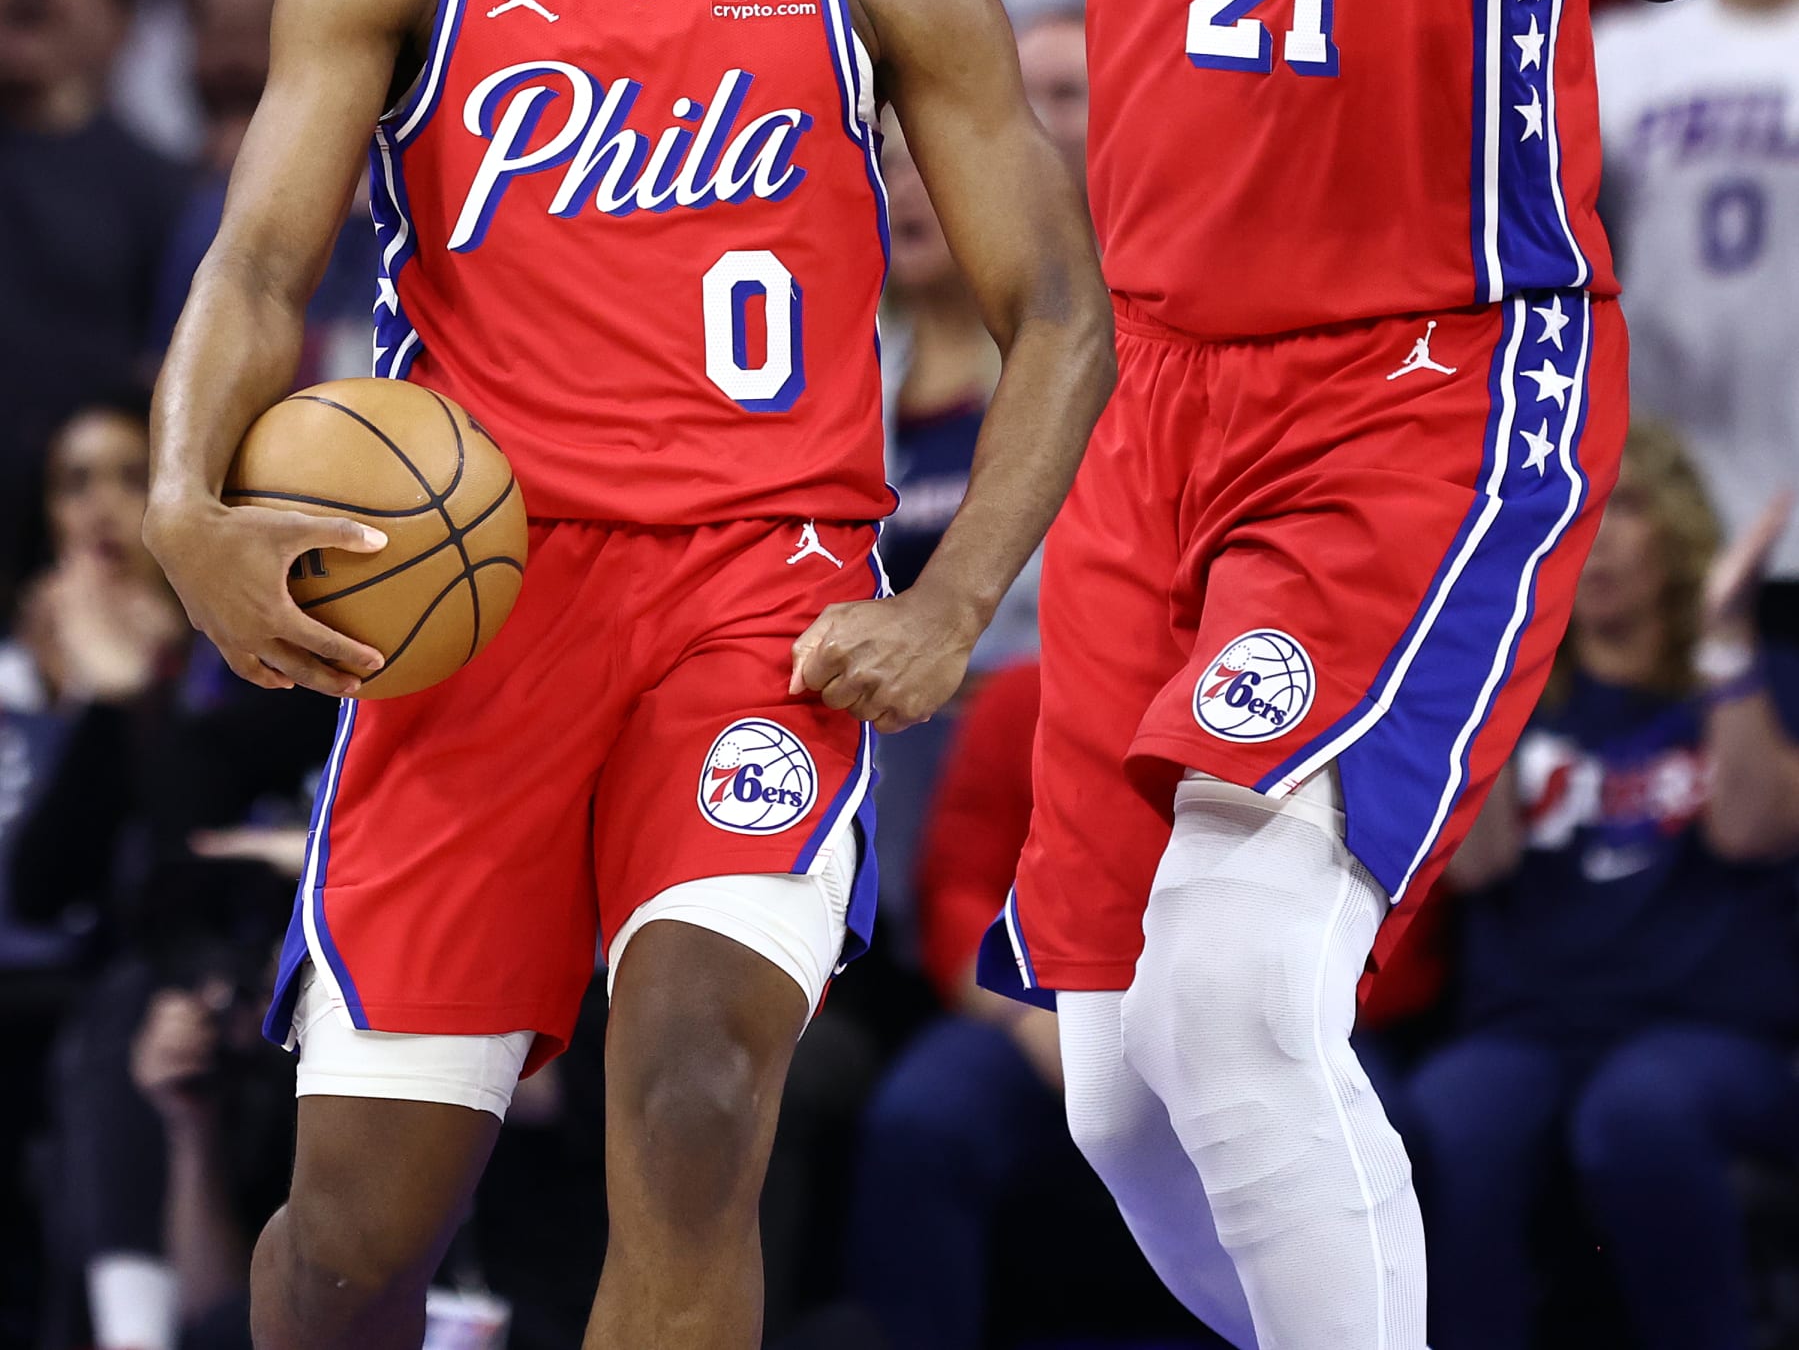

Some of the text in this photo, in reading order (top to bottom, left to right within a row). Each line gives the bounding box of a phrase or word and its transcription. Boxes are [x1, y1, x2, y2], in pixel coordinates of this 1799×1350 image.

[713, 3, 817, 20] crypto.com
[447, 60, 815, 252] Phila
[702, 250, 806, 412] 0
[1203, 662, 1288, 726] 76ers
[709, 763, 803, 808] 76ers
